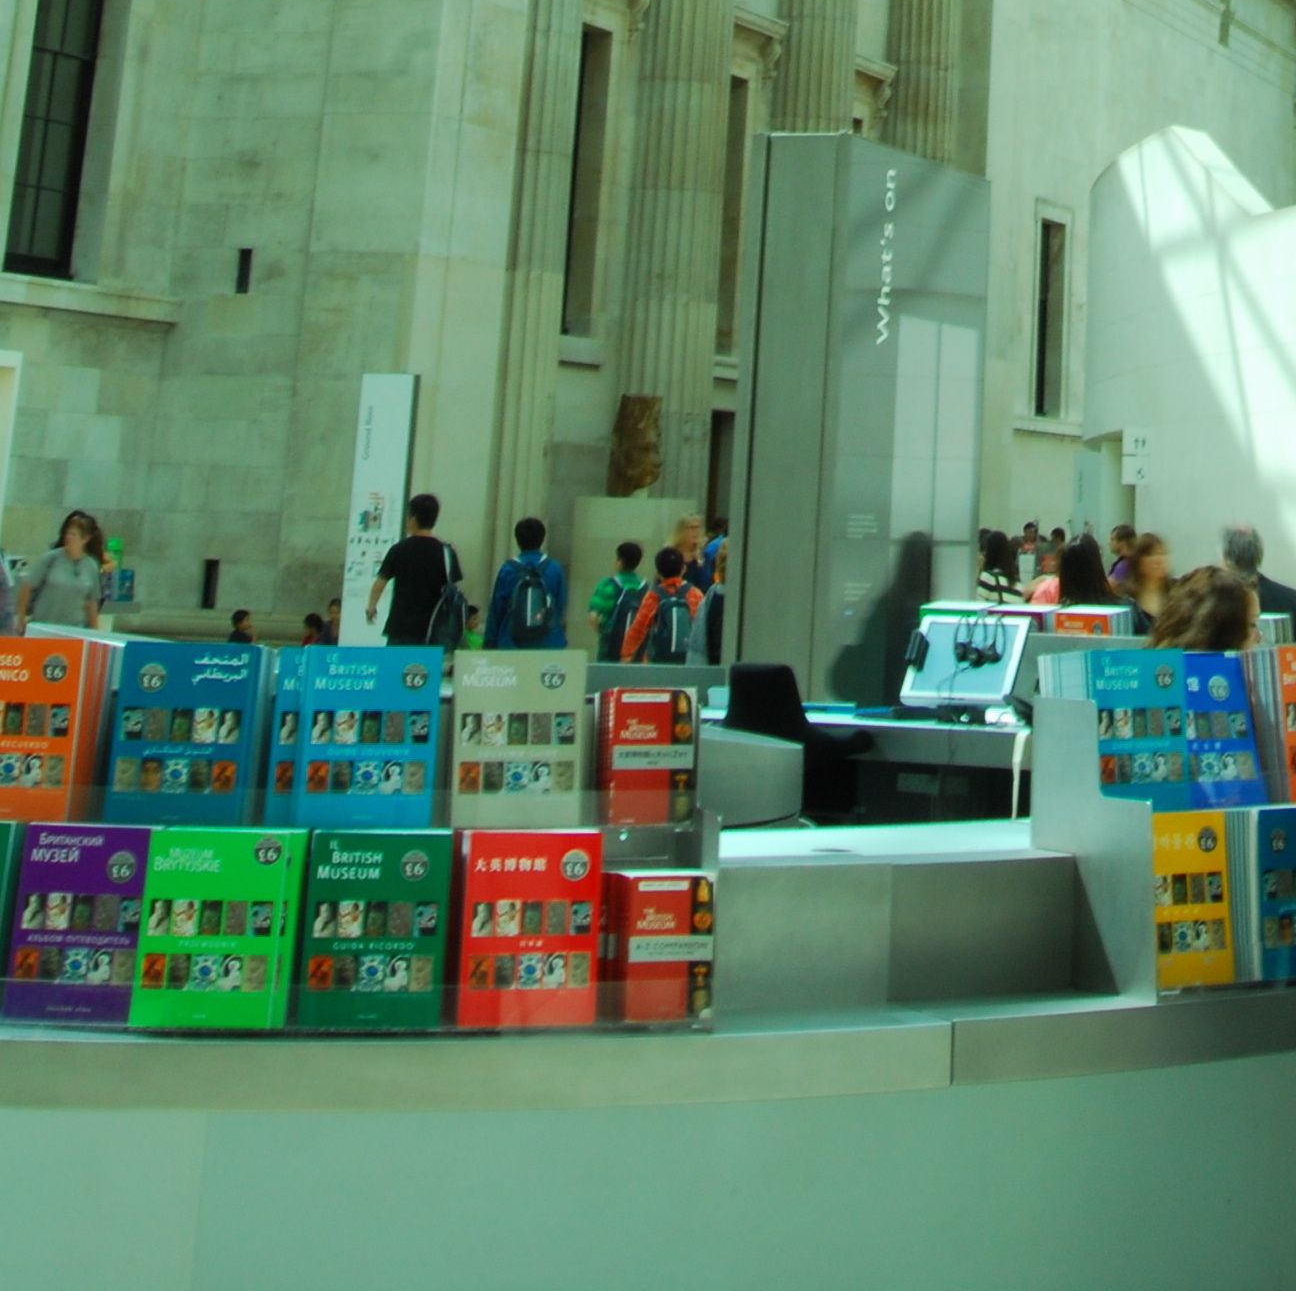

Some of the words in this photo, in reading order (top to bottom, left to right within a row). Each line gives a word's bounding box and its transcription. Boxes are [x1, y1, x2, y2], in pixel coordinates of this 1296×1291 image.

[884, 168, 897, 212] on
[875, 222, 894, 345] What's
[0, 654, 23, 667] SEO
[0, 668, 31, 682] NICO
[328, 664, 379, 676] BRITISH
[314, 677, 375, 691] MUSEUM
[1095, 678, 1139, 690] MUSEUM
[30, 846, 80, 863] МУЗЕЙ
[331, 851, 384, 865] BRITISH
[316, 865, 381, 880] MUSEUM
[404, 862, 426, 877] £6
